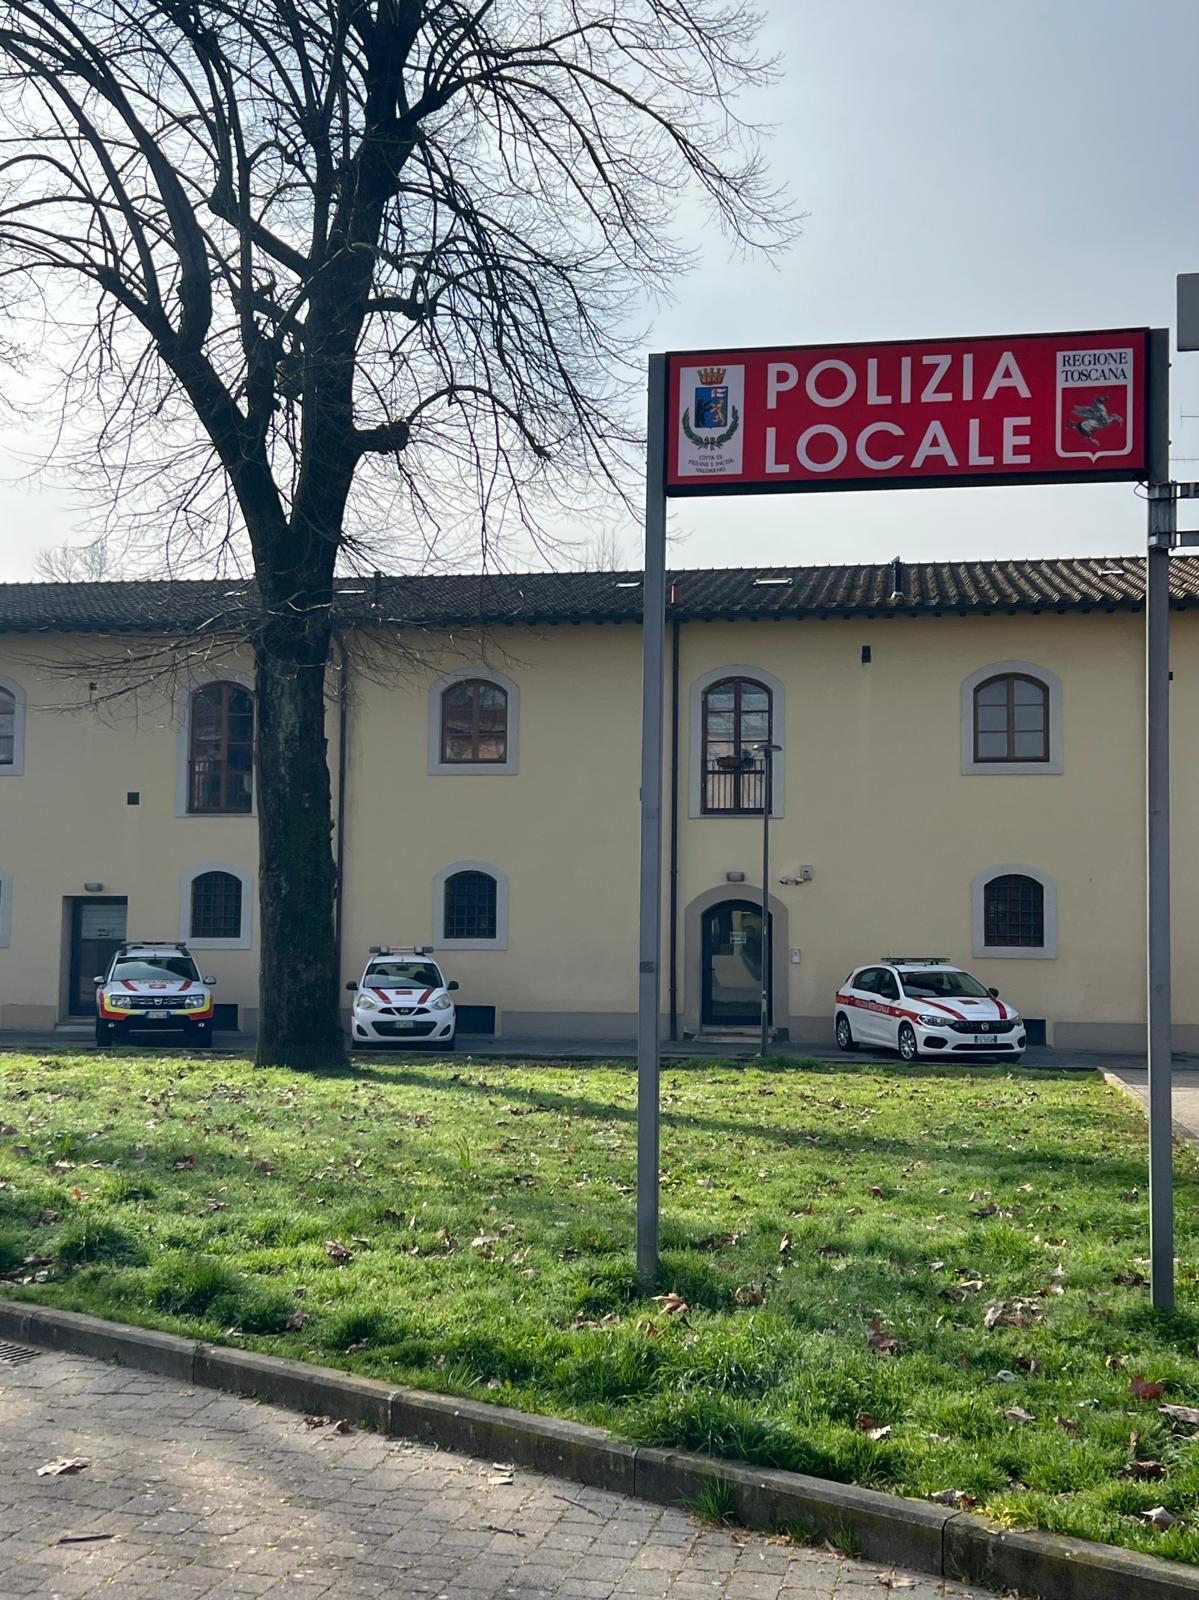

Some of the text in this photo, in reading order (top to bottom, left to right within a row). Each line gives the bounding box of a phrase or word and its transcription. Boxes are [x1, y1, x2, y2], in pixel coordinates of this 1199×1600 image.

[1062, 352, 1128, 367] REGIONE
[1062, 368, 1127, 382] TOSCANA
[766, 352, 1032, 409] POLIZIA
[765, 416, 1031, 473] LOCALE
